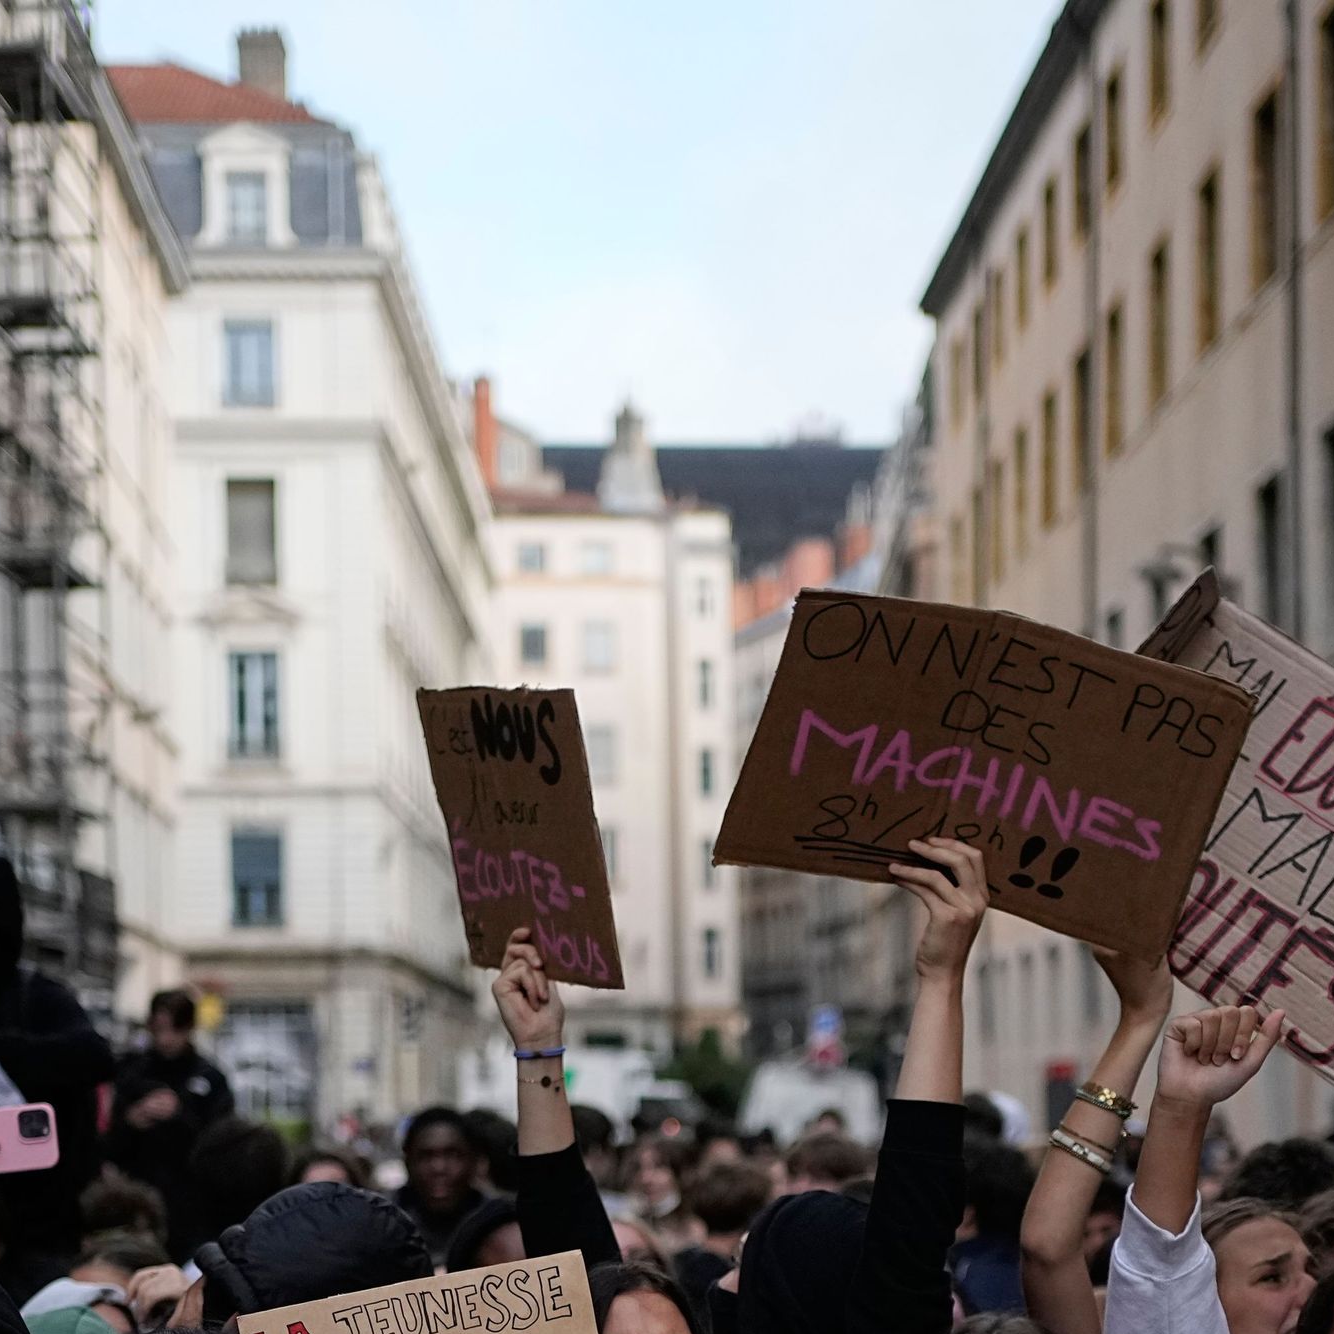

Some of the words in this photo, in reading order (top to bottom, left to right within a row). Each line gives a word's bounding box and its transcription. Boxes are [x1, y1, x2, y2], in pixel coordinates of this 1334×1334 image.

[803, 601, 916, 666] ON
[921, 623, 1117, 710] N'EST
[1122, 683, 1224, 759] PAS
[470, 694, 562, 785] NOUS
[941, 690, 1056, 766] DES
[790, 709, 1163, 862] MACHINES
[534, 916, 611, 980] NOUS
